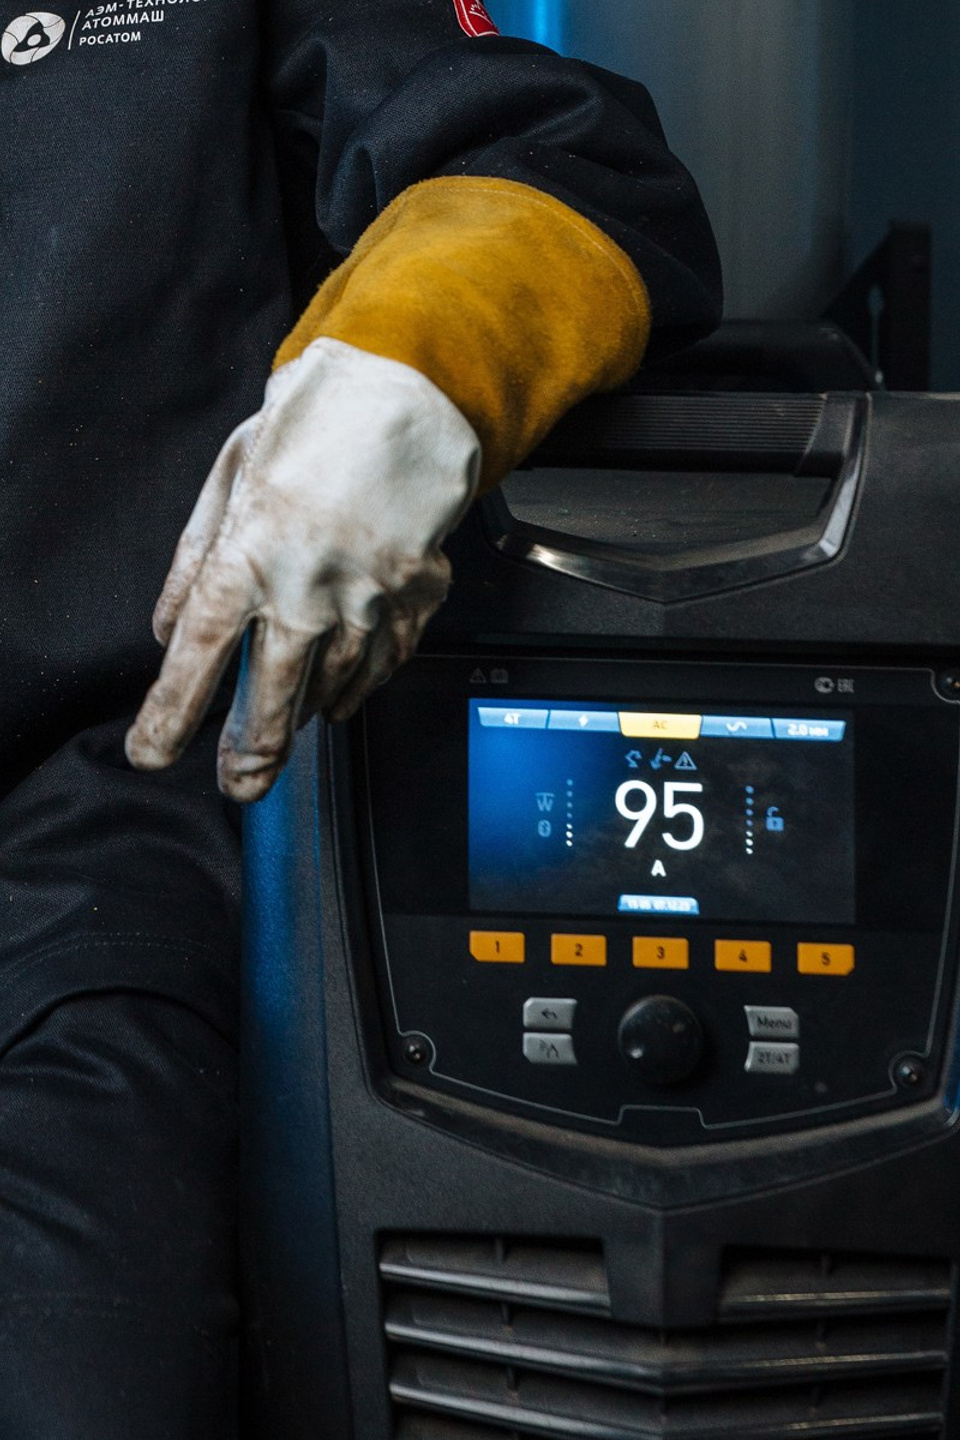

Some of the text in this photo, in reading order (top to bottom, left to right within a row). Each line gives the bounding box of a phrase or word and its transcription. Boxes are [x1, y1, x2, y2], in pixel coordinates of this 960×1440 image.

[81, 10, 165, 31] АТОММАШ
[79, 31, 142, 46] РОСАТОМ
[615, 780, 705, 851] 95
[574, 944, 584, 957] 2
[656, 946, 666, 959] 3
[737, 949, 747, 962] 4
[821, 953, 831, 966] 5
